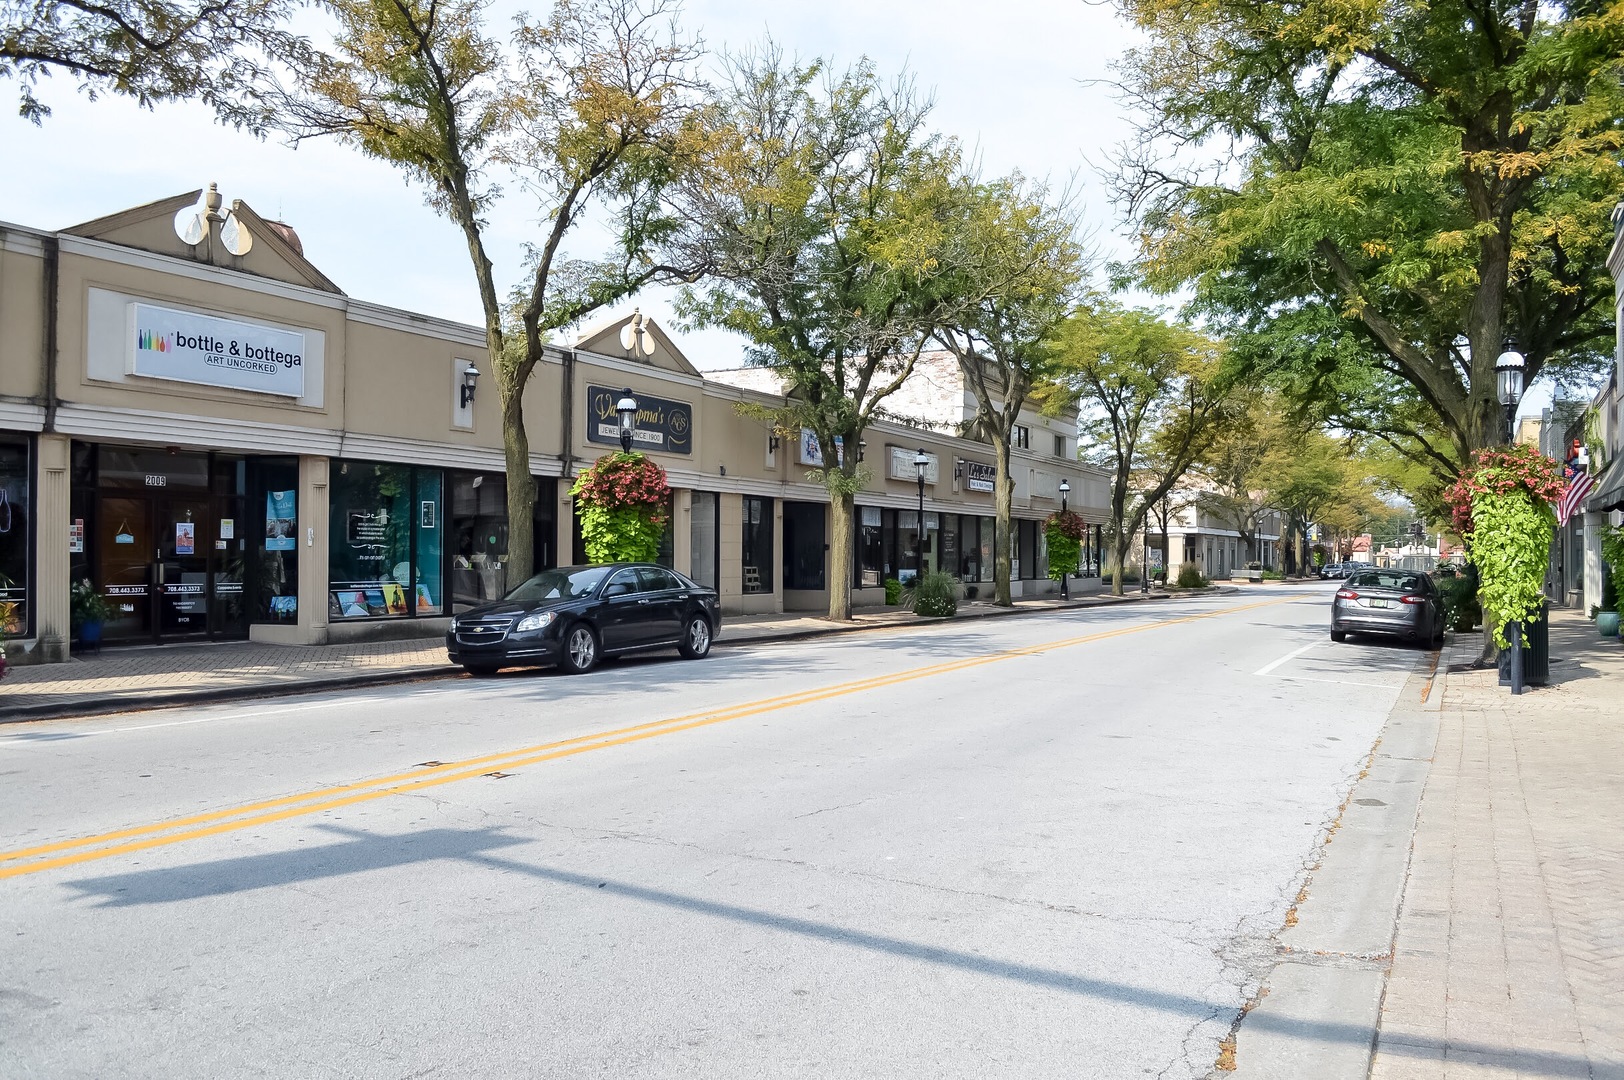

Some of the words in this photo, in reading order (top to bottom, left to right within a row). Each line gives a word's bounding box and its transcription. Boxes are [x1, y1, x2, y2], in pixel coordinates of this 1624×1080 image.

[176, 331, 224, 353] bottle
[229, 340, 241, 357] &
[245, 342, 302, 369] bottega
[206, 355, 225, 365] ART
[226, 358, 276, 373] UNCORKED
[648, 433, 661, 442] 1900
[146, 475, 165, 486] 2009
